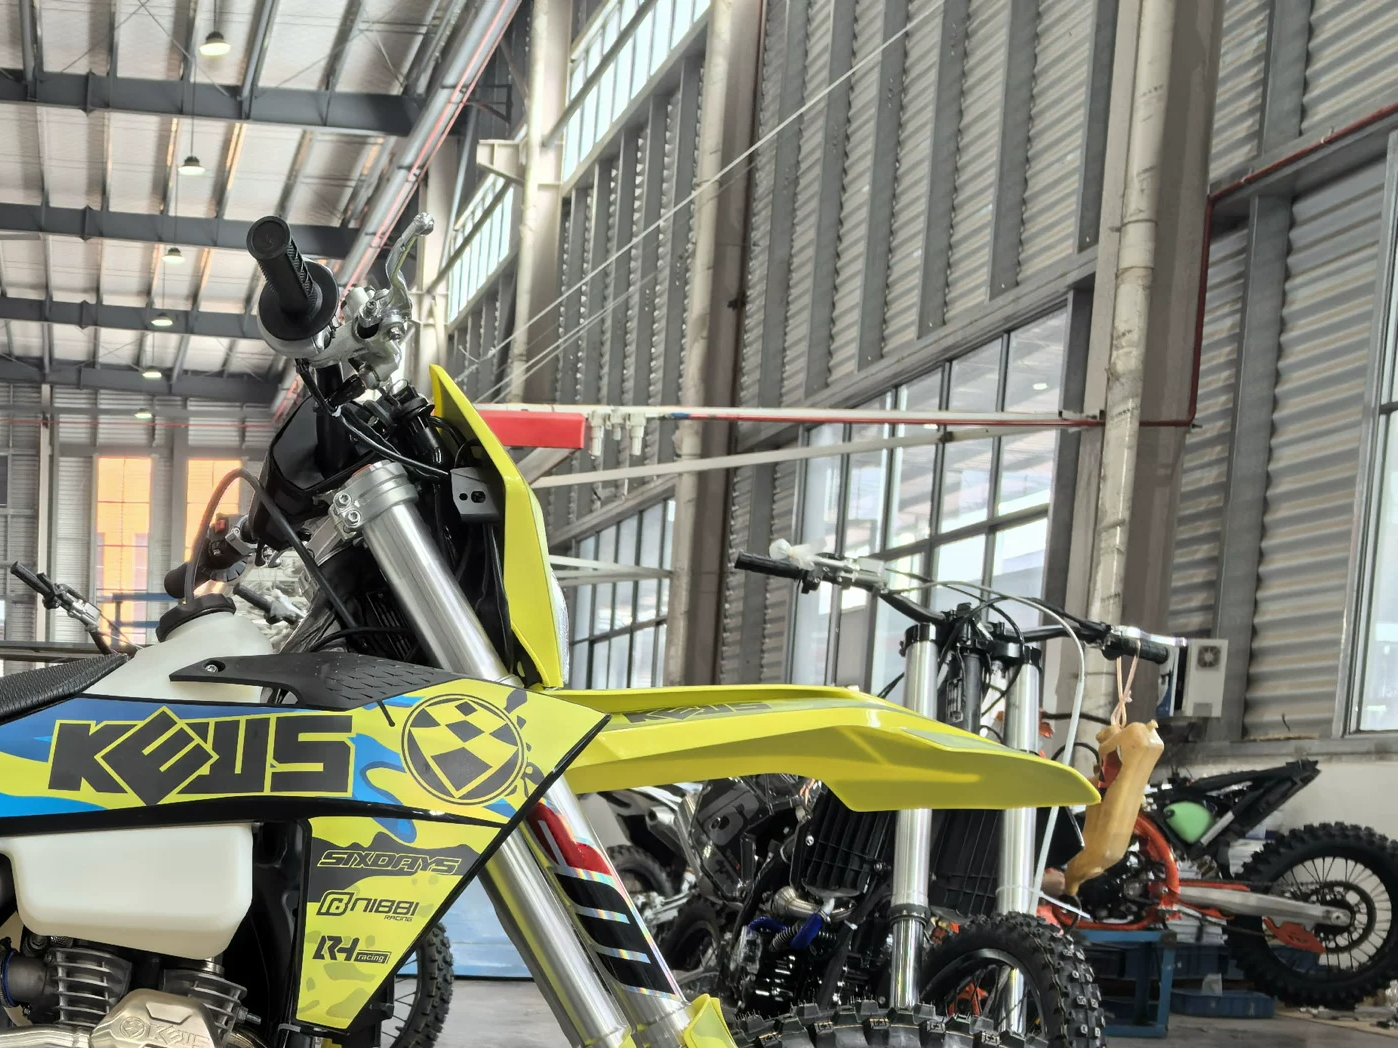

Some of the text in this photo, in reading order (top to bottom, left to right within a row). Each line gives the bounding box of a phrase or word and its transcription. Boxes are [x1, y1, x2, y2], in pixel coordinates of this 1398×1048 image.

[49, 706, 356, 806] KEWS
[317, 850, 462, 875] SIXDAYS
[357, 953, 385, 963] racing
